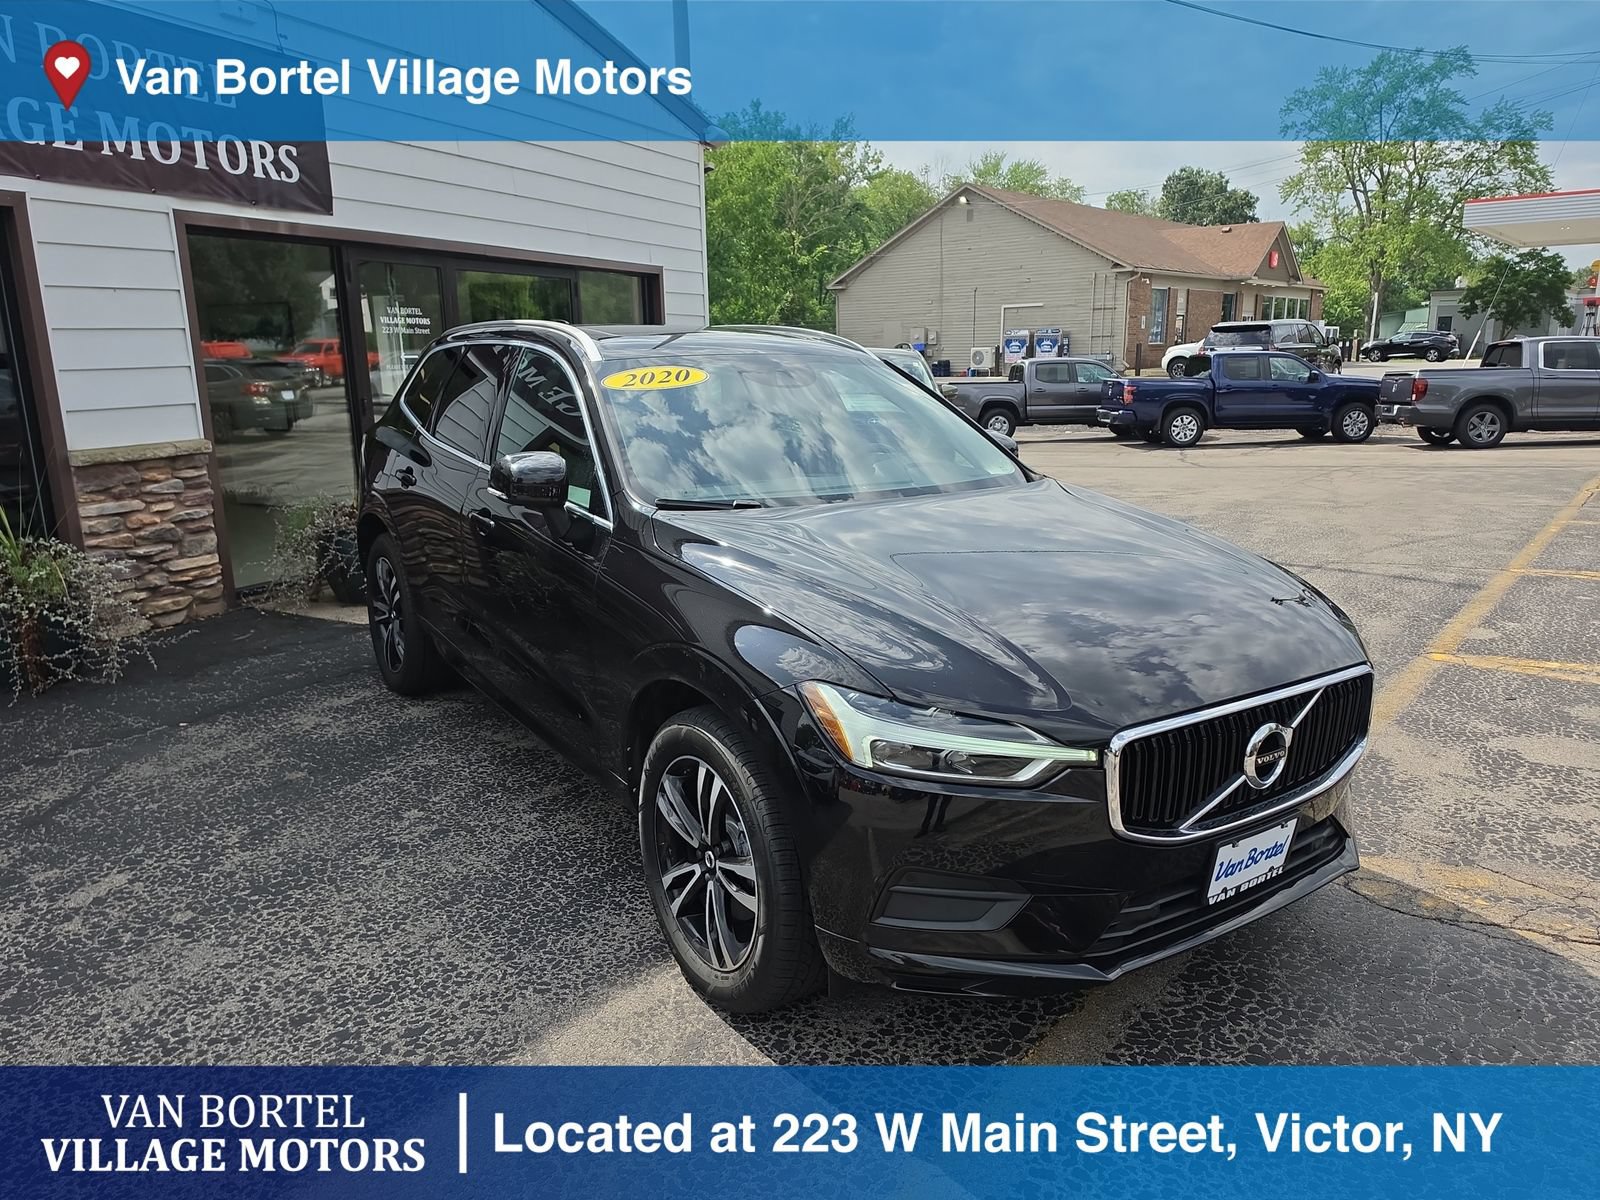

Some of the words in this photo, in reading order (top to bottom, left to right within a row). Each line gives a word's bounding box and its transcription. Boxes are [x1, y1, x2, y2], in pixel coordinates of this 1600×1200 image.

[95, 110, 301, 184] MOTORS
[386, 306, 400, 315] VAN
[400, 307, 423, 316] BORTEL
[380, 316, 405, 325] VILLAGE
[405, 317, 431, 325] MOTORS
[382, 326, 393, 334] 223
[415, 327, 431, 335] Street
[621, 369, 690, 388] 2020
[1256, 750, 1286, 765] VOLVO
[1208, 886, 1237, 905] VAN
[1239, 866, 1285, 893] BORTEL
